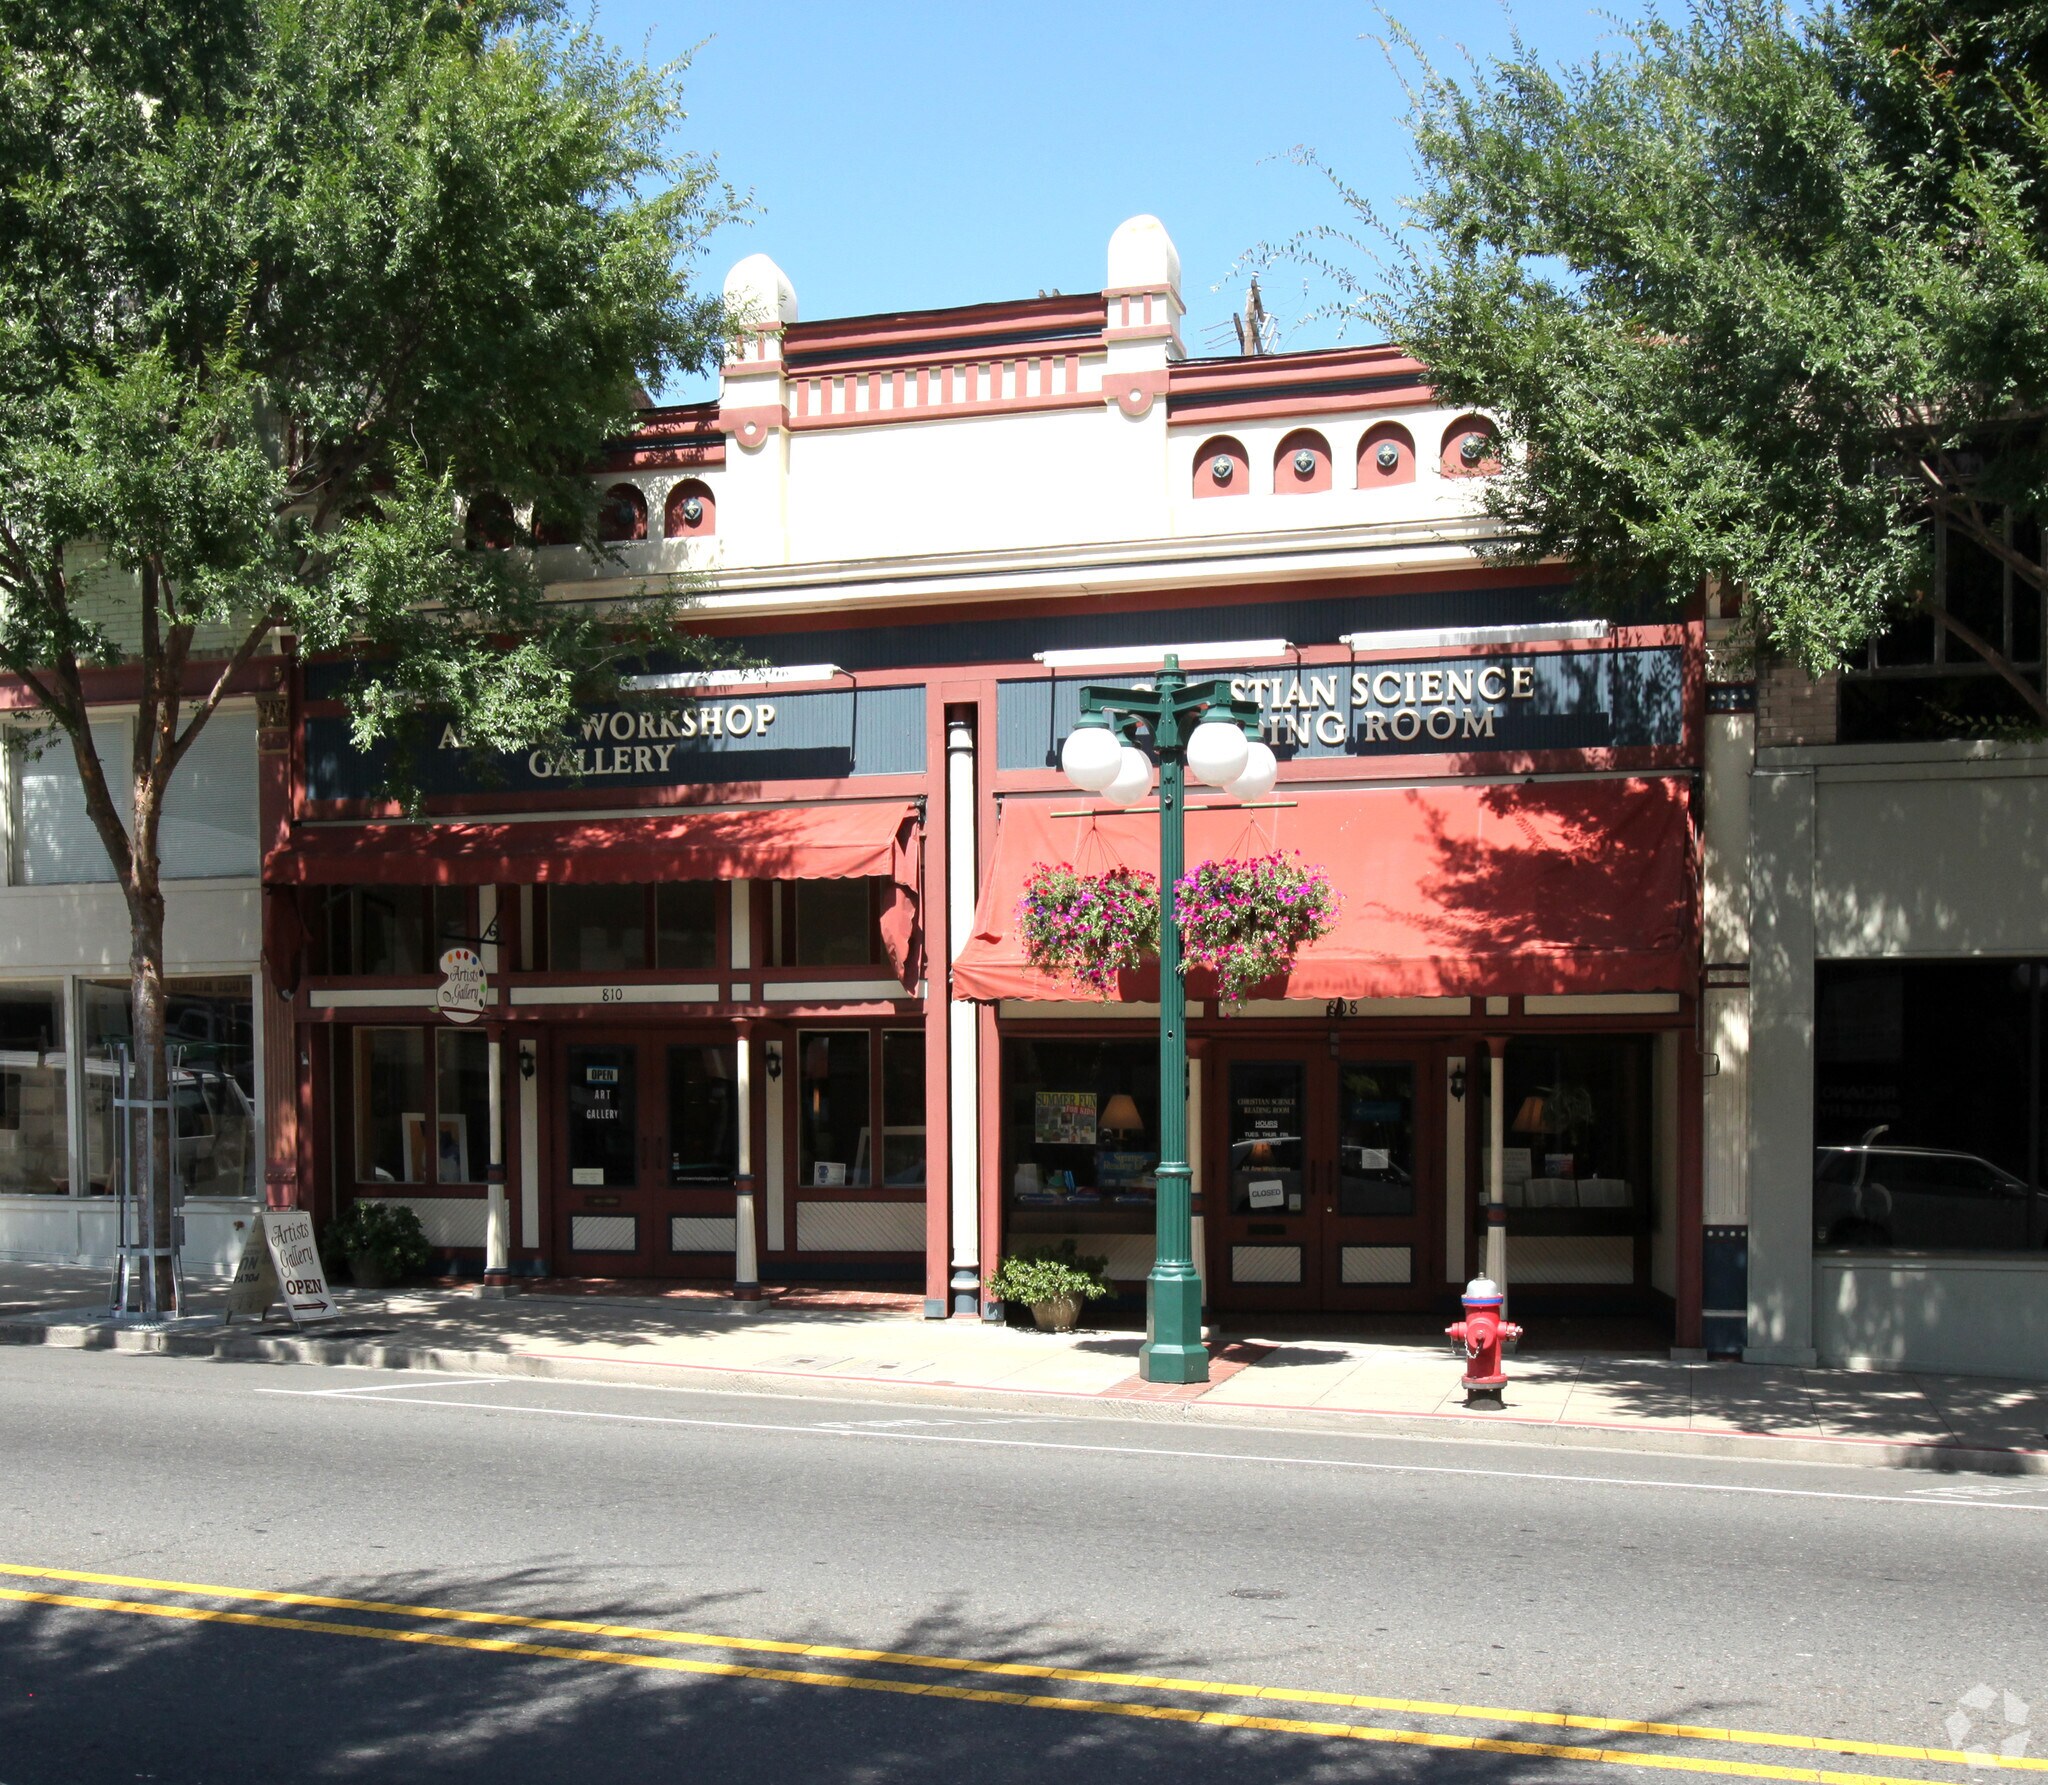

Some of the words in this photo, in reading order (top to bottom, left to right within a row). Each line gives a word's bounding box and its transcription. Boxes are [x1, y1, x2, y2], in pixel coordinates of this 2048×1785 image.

[1351, 666, 1535, 707] SCIENCE
[580, 703, 776, 740] WORKSHOP
[1366, 707, 1496, 742] ROOM
[529, 744, 675, 778] GALLERY
[452, 984, 479, 1005] Gallery
[602, 988, 623, 1002] 810
[592, 1069, 613, 1080] OPEN
[594, 1089, 611, 1100] ART
[1036, 1093, 1075, 1105] SUMMER
[1079, 1094, 1097, 1107] FUN
[586, 1109, 619, 1119] GALLERY
[1252, 1188, 1281, 1198] CLOSED
[279, 1245, 314, 1278] Gallery
[286, 1279, 323, 1295] OPEN
